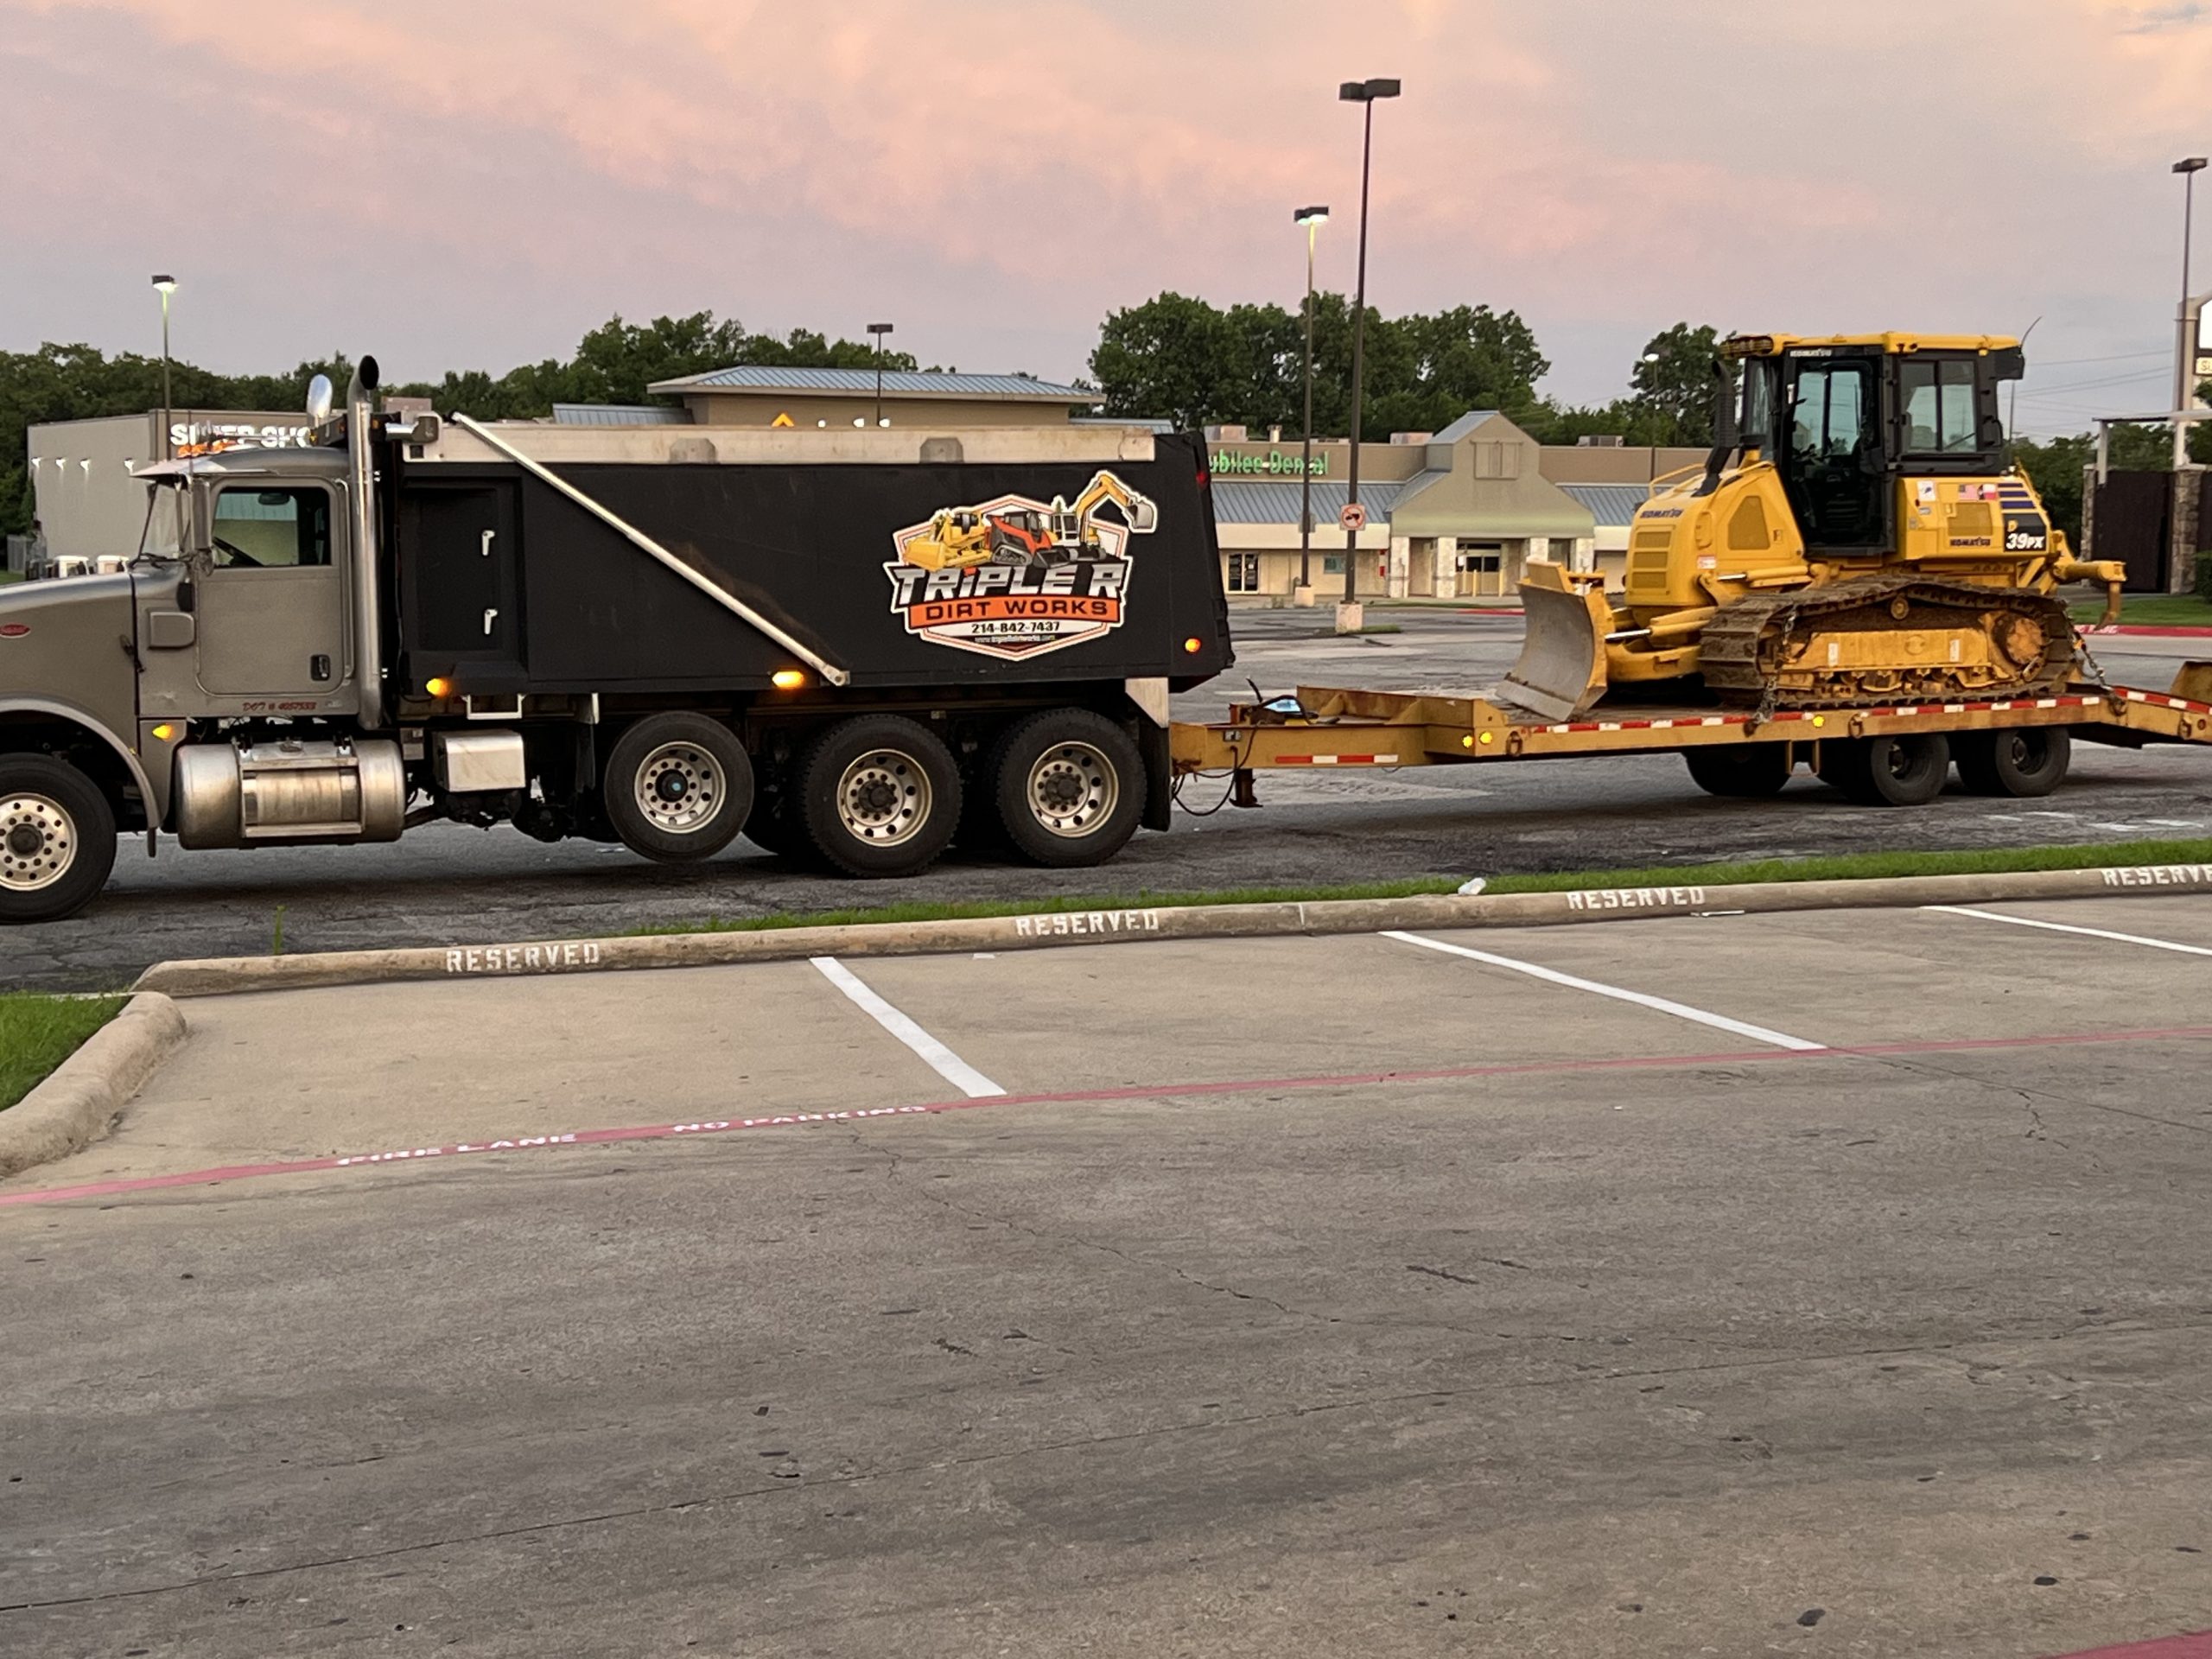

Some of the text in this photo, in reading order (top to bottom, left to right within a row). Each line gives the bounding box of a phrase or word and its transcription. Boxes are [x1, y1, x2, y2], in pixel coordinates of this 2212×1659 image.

[1270, 450, 1328, 474] Denal
[2005, 532, 2044, 549] 39PX
[1088, 563, 1124, 598] R
[925, 599, 1108, 620] DIRT WORKS
[971, 621, 1060, 634] 214-842-7437
[1566, 887, 1706, 909] RESERVED
[1015, 910, 1160, 936] RESERVED
[446, 943, 600, 973] RESERVED
[337, 1106, 926, 1165] FIRE LANE NO PARKING
